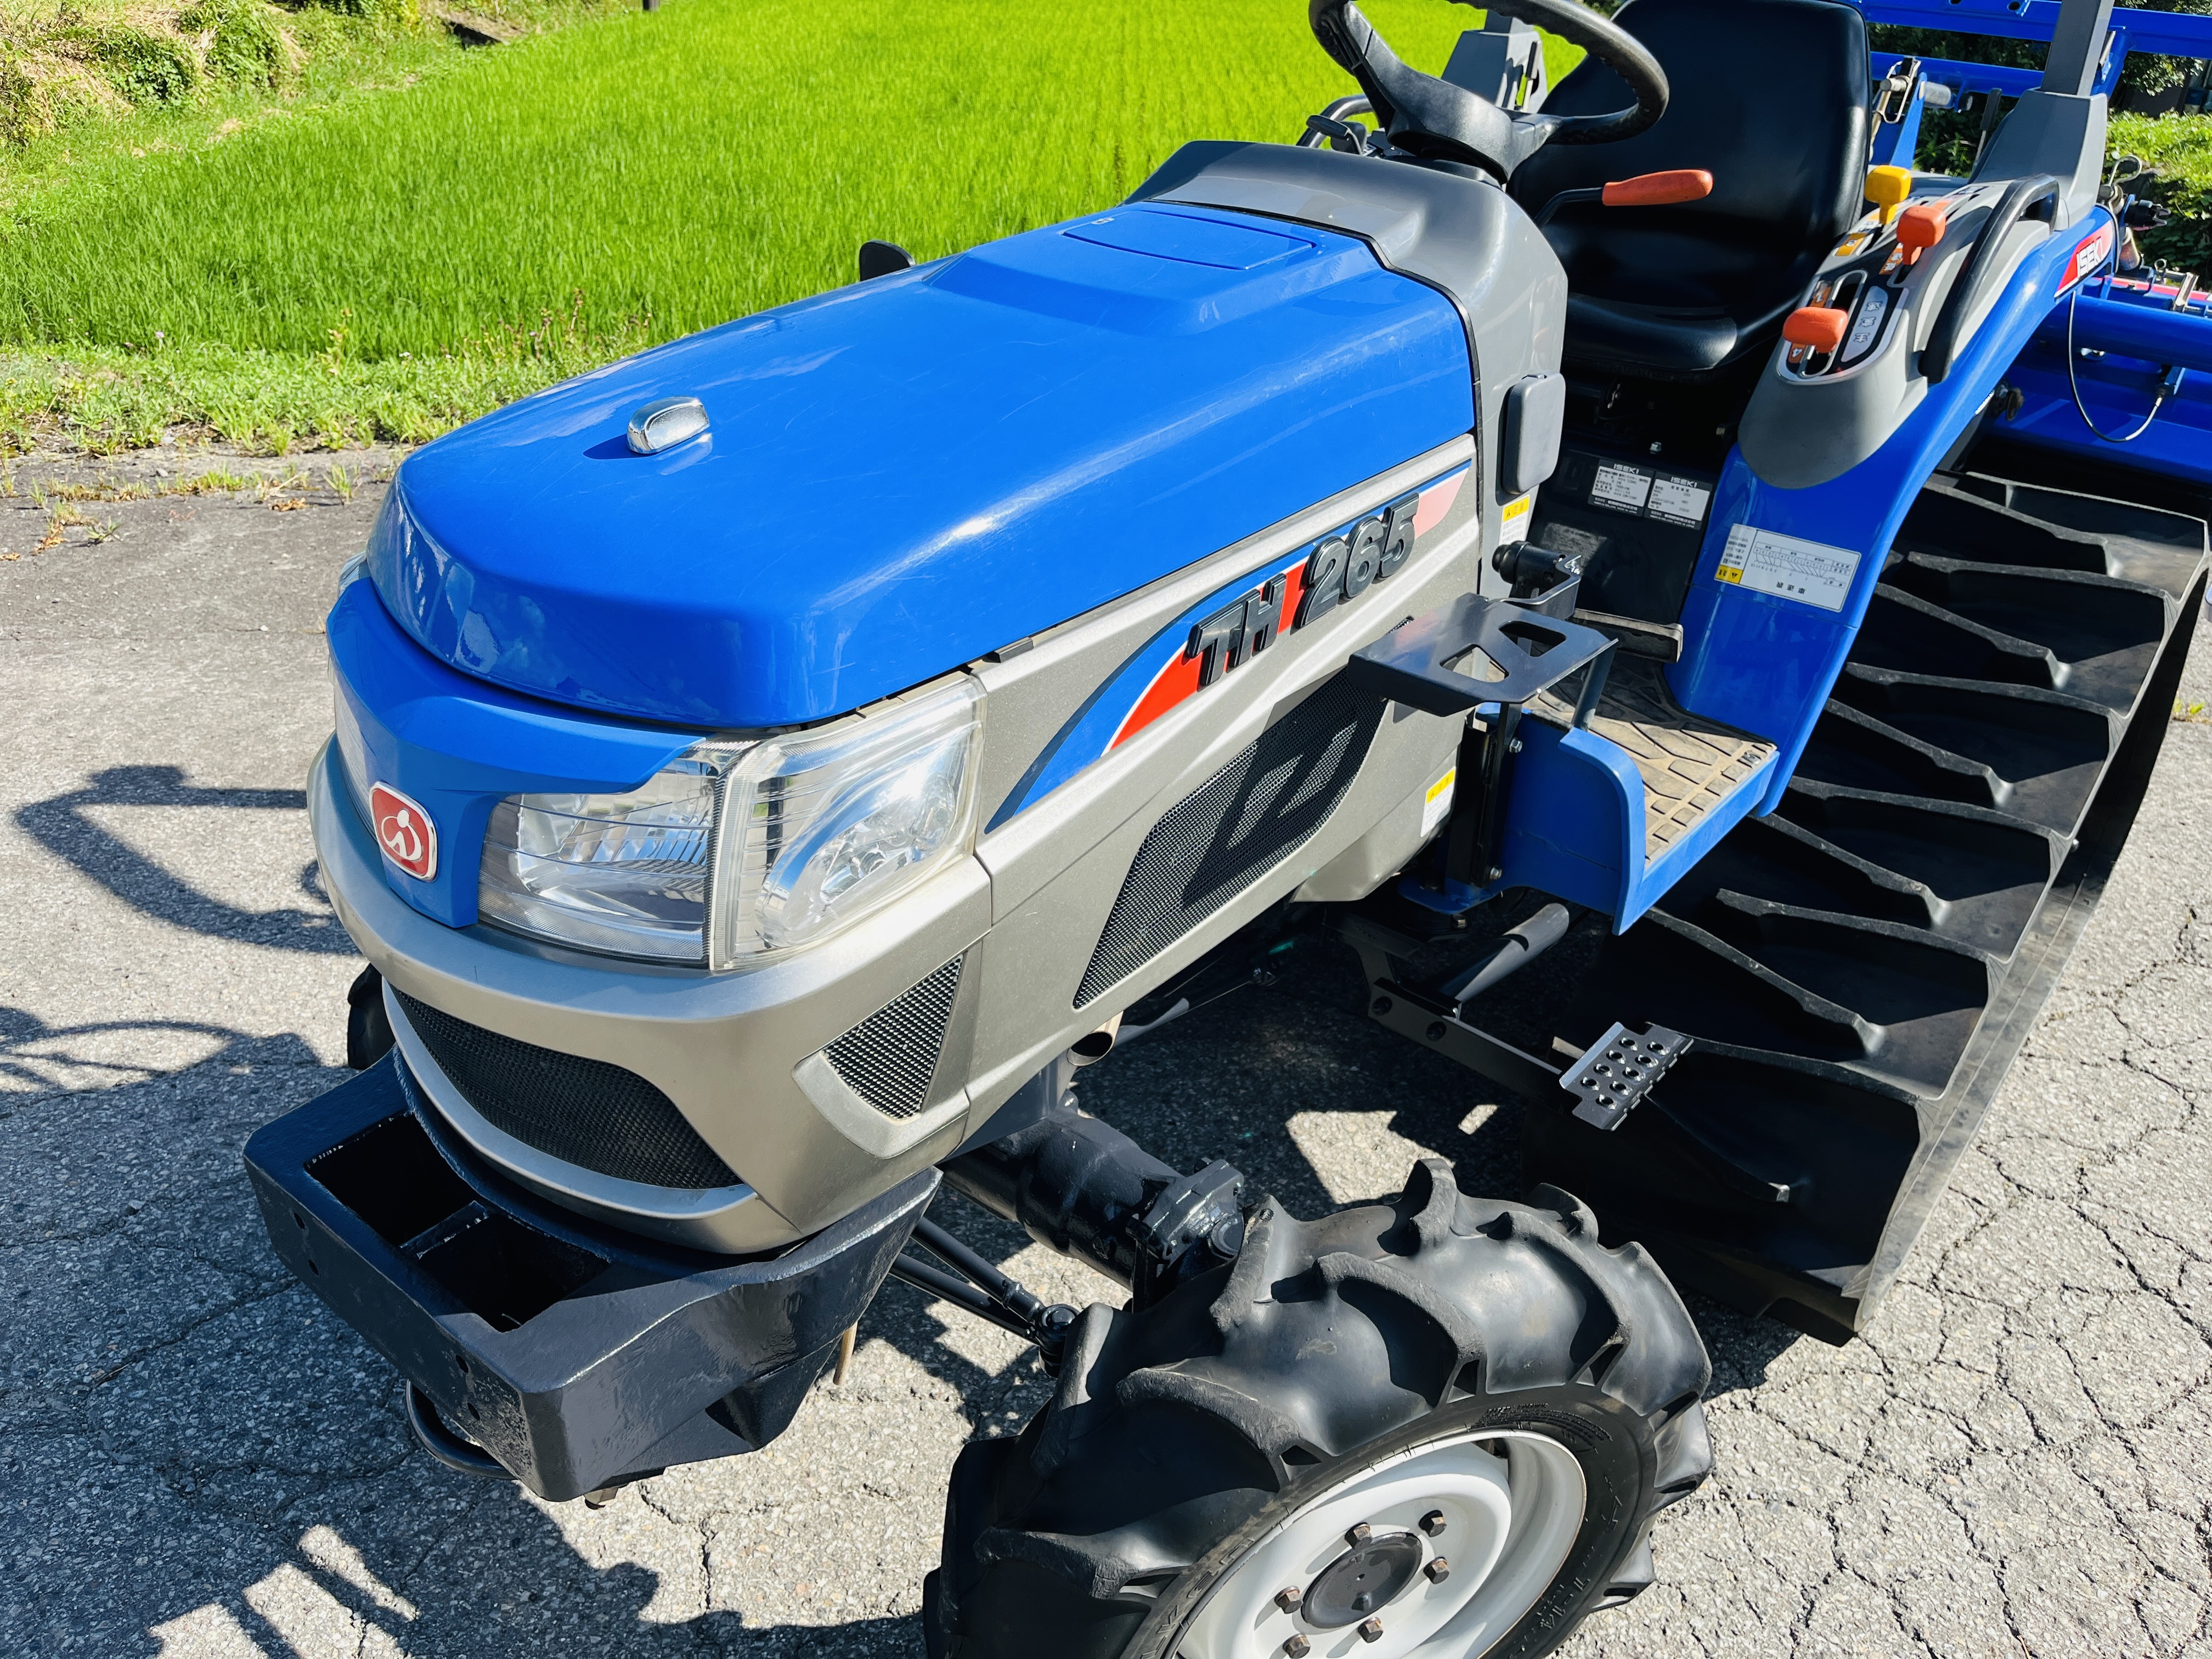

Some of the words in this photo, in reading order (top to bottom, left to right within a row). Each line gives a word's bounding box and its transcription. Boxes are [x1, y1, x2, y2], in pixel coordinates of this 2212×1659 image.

[2075, 236, 2103, 279] ISEKI
[1613, 463, 1639, 475] ISEKI
[1671, 476, 1698, 488] ISEKI
[1185, 572, 1286, 687] TH
[1292, 492, 1420, 629] 265
